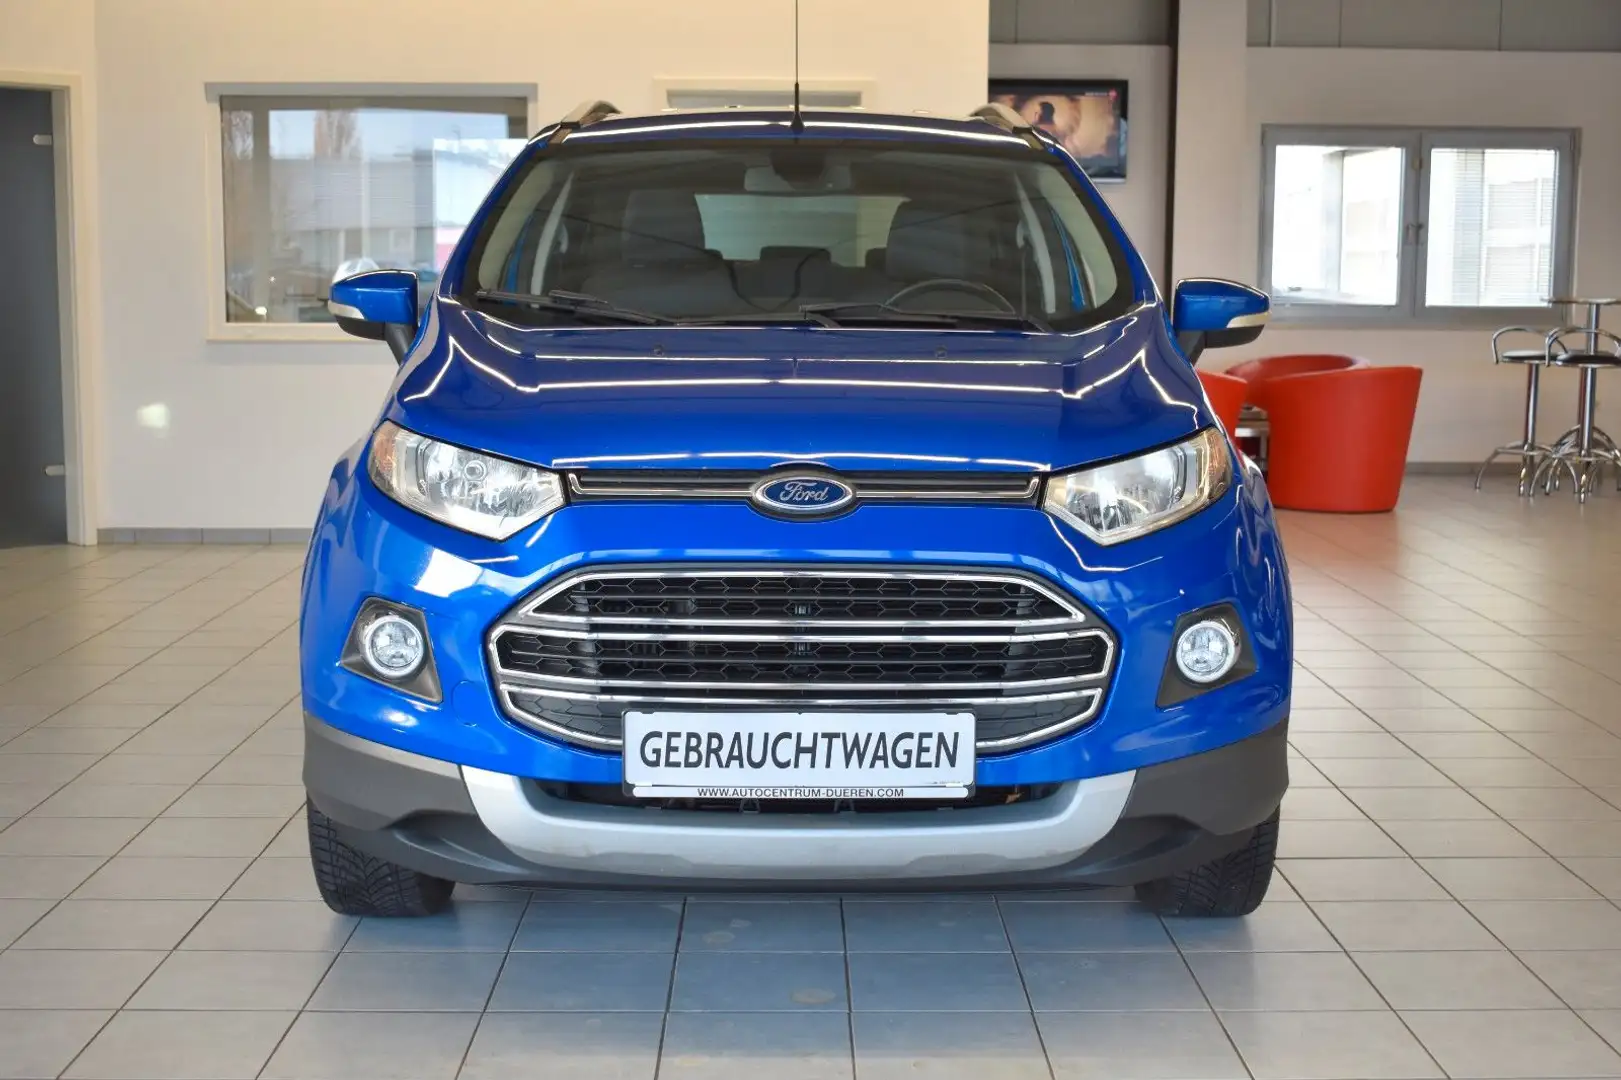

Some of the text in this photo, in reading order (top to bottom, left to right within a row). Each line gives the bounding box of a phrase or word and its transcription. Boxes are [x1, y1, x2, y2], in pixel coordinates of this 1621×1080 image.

[780, 481, 829, 501] Ford
[640, 730, 960, 769] GEBRAUCHTWAGEN
[697, 787, 904, 798] WWW.AUTOCENTRUM-DUEREN.COM
